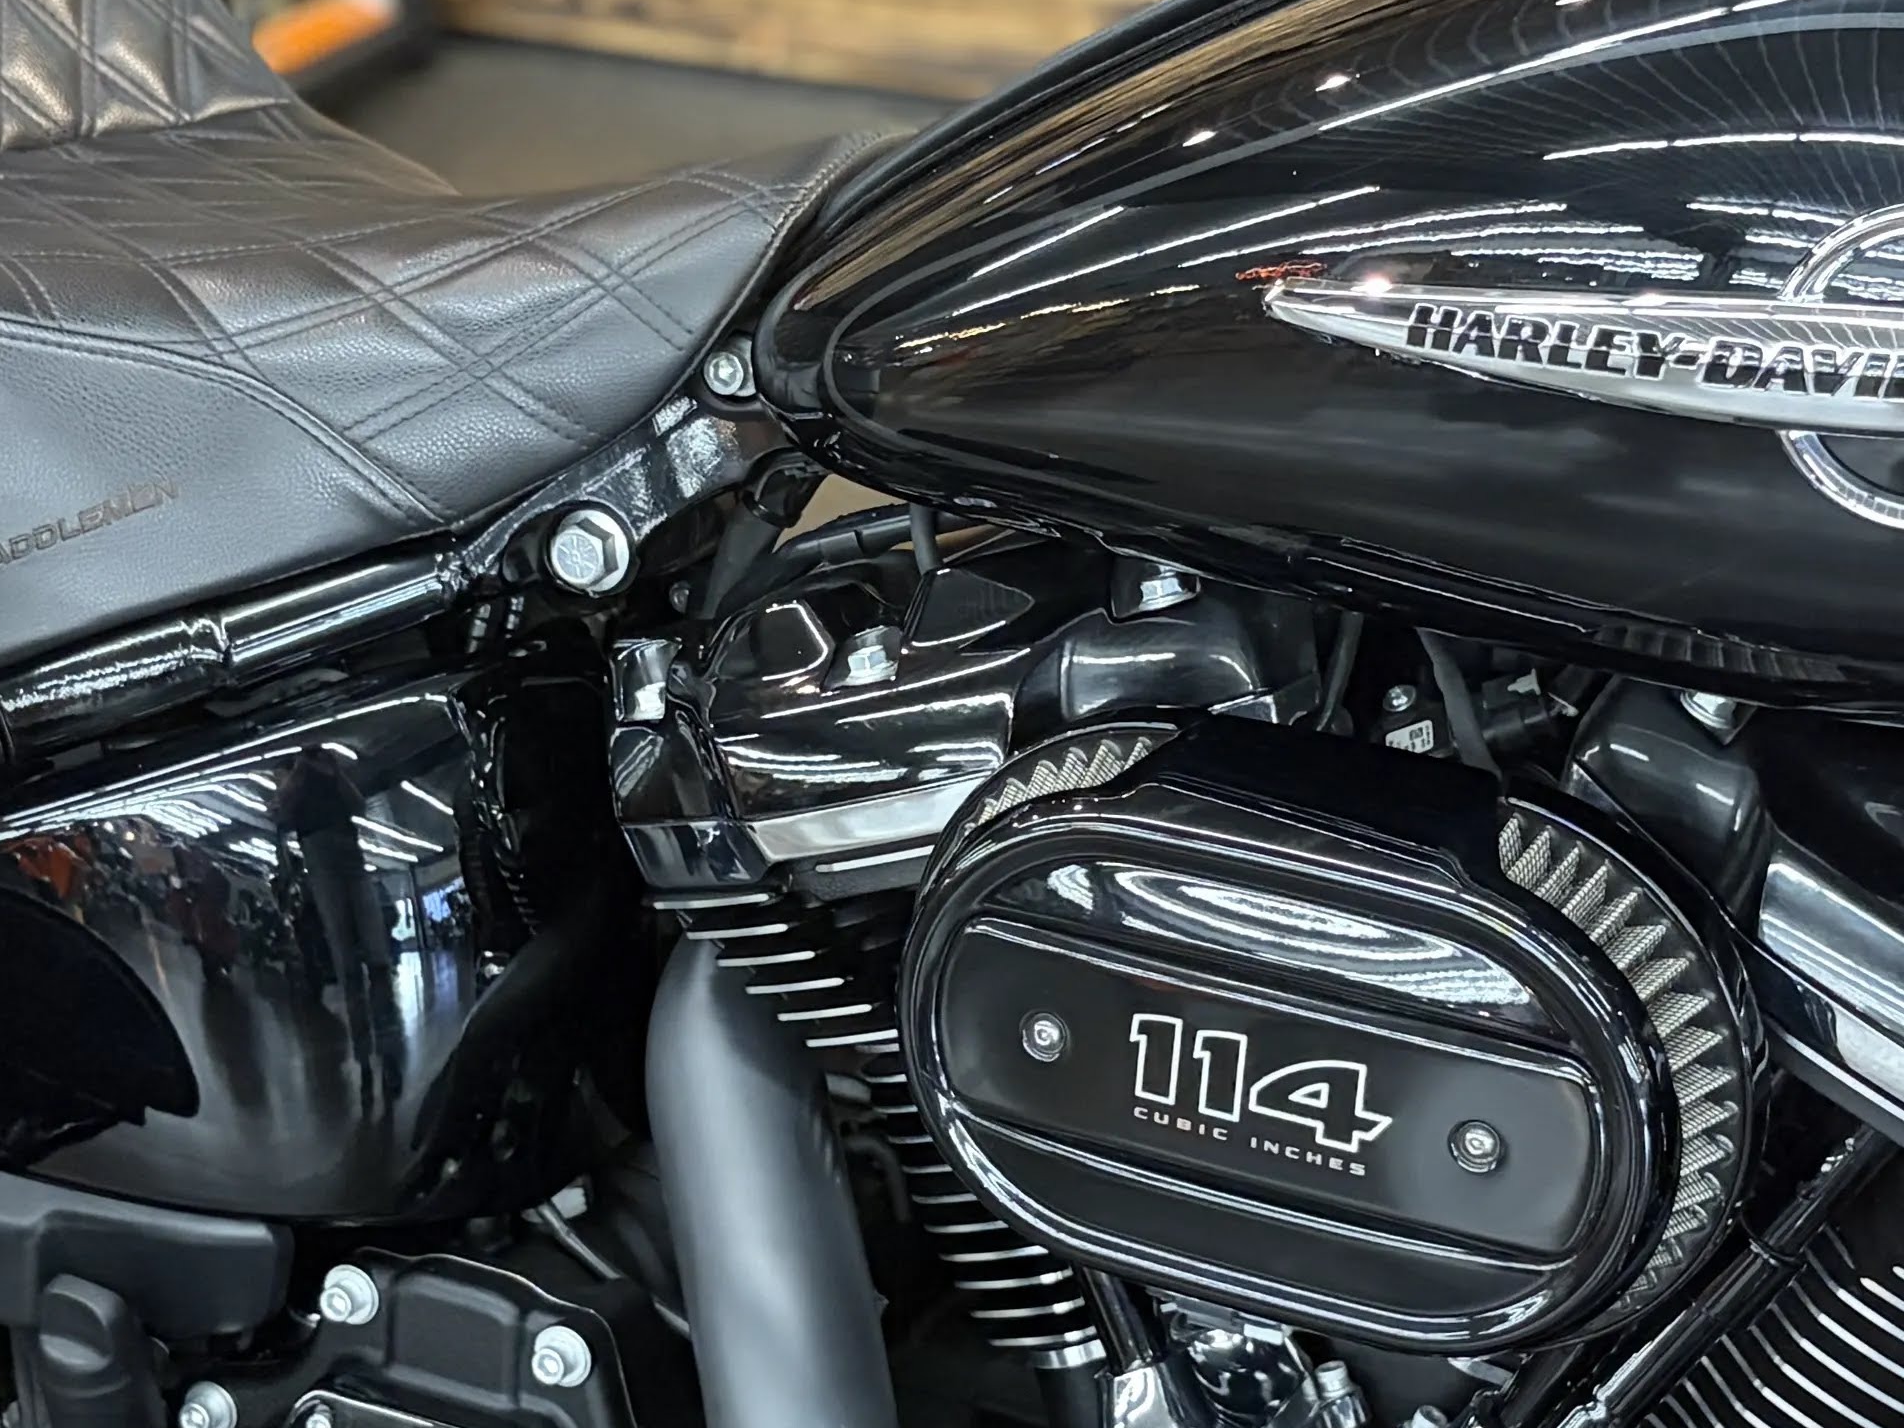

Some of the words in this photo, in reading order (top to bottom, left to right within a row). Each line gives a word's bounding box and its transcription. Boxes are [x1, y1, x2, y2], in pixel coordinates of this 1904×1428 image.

[1129, 1013, 1393, 1154] 114
[1132, 1105, 1229, 1143] CUBIC
[1249, 1136, 1368, 1177] INCHES
